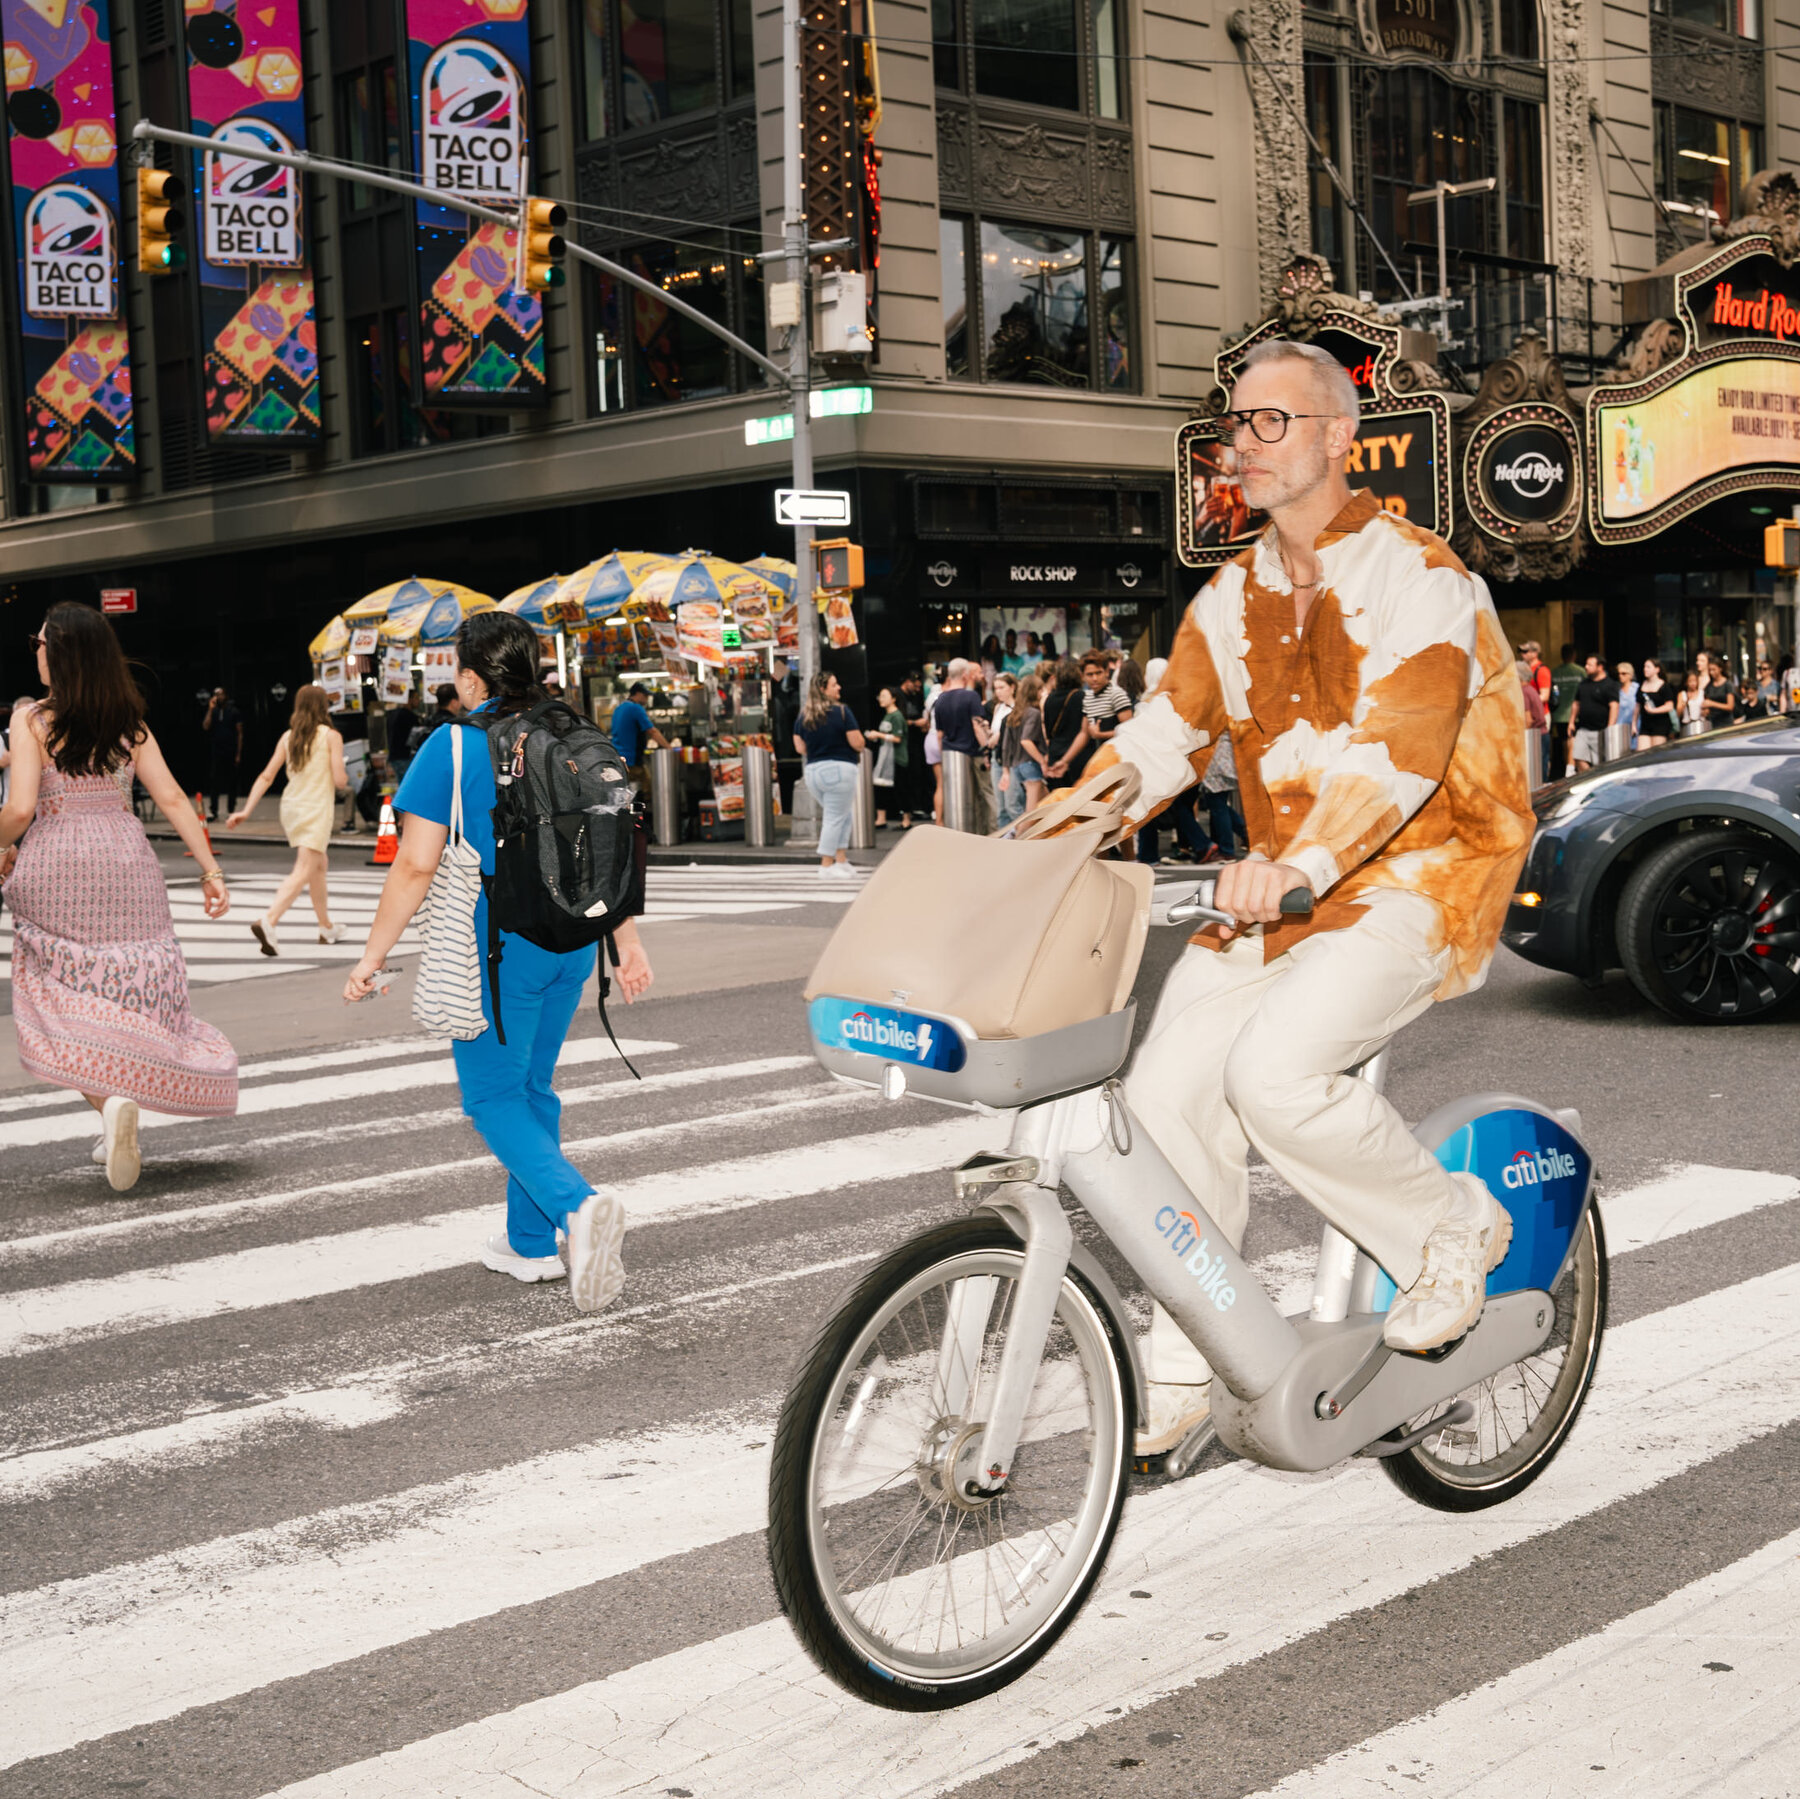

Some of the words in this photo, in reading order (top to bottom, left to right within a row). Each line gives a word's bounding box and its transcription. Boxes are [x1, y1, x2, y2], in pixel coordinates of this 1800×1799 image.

[1383, 28, 1448, 60] BROADWAY
[428, 133, 512, 163] TACO
[436, 163, 511, 191] BELL
[211, 203, 289, 228] TACO
[217, 230, 288, 254] BELL
[31, 261, 104, 284] TACO
[38, 285, 104, 307] BELL
[1714, 282, 1769, 330] Hard
[1718, 388, 1739, 408] ENJOY
[1741, 390, 1754, 409] OUR
[1756, 392, 1783, 413] LIMITED
[1732, 415, 1768, 437] AVAILABLE
[1769, 418, 1784, 438] JULY
[1344, 433, 1414, 473] RTY
[1495, 462, 1533, 481] Hard
[1533, 462, 1564, 483] Rock
[1010, 566, 1043, 581] ROCK
[1045, 566, 1077, 581] SHOP
[842, 1012, 873, 1042] citi
[874, 1017, 917, 1051] bike
[1502, 1150, 1538, 1189] citi
[1534, 1147, 1577, 1182] bike
[1154, 1205, 1200, 1258] citi
[1184, 1238, 1237, 1312] bike
